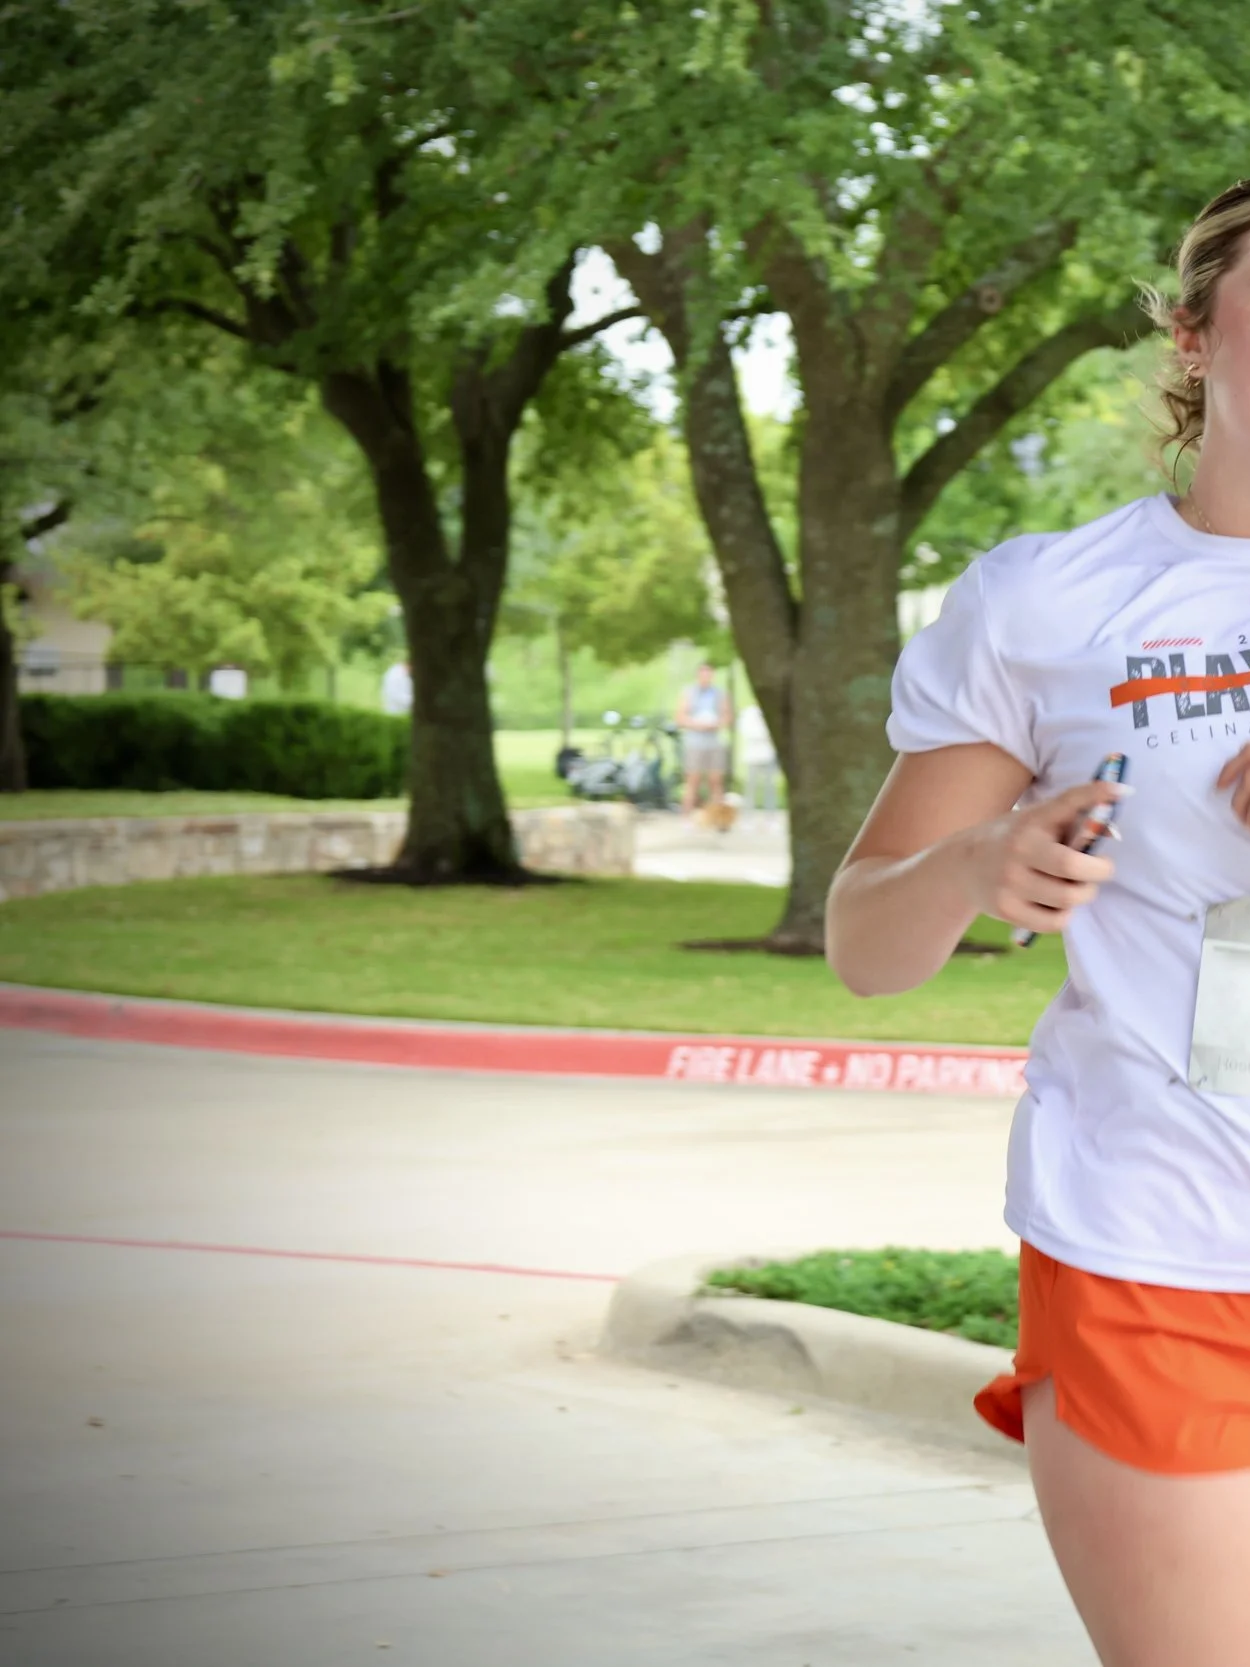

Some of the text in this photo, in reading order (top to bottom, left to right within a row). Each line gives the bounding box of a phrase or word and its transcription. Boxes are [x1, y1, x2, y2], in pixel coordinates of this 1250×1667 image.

[665, 1045, 737, 1083] FIRE
[735, 1048, 822, 1087] LANE
[844, 1052, 893, 1091] NO
